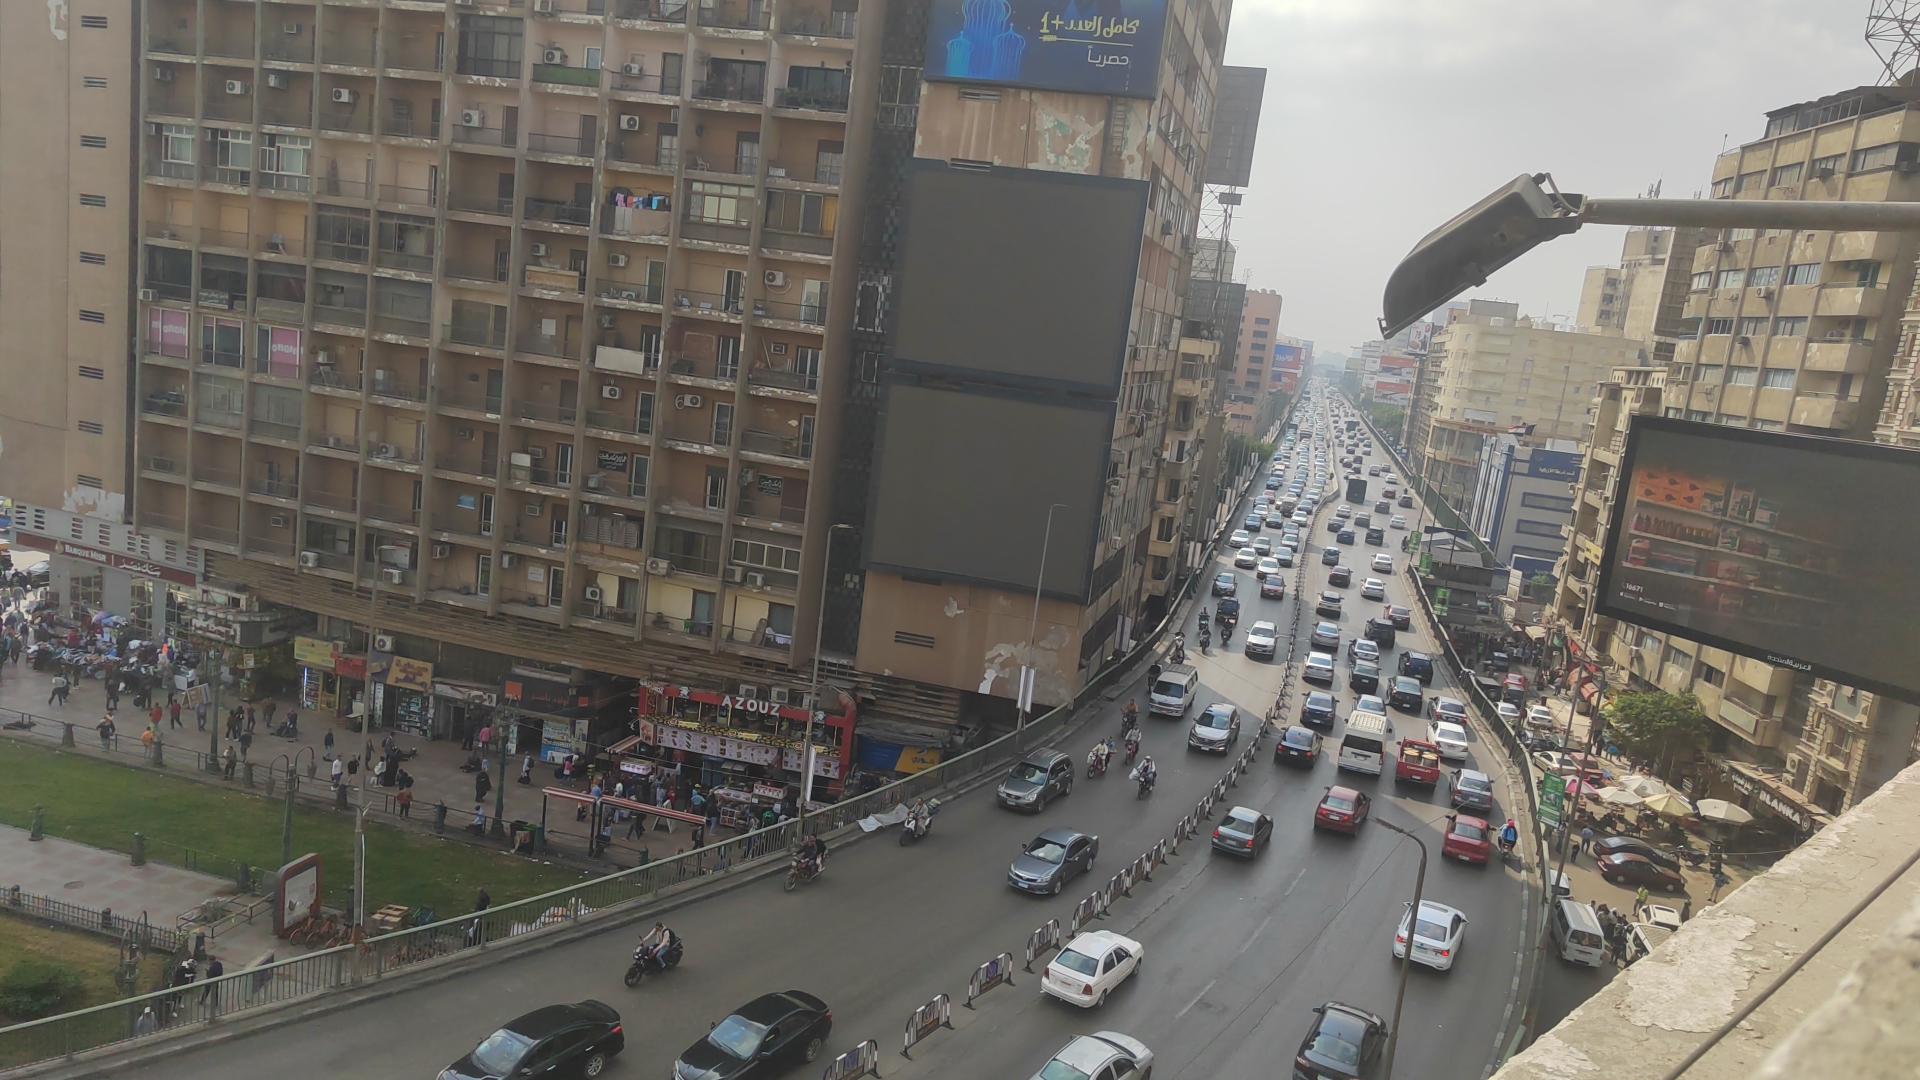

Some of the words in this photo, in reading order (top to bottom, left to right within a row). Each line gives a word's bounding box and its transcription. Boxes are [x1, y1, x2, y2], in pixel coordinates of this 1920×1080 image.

[1102, 17, 1140, 38] كامل
[65, 544, 90, 558] BANQUE
[721, 695, 781, 717] AZOUZ
[1760, 790, 1801, 825] BLANKA
